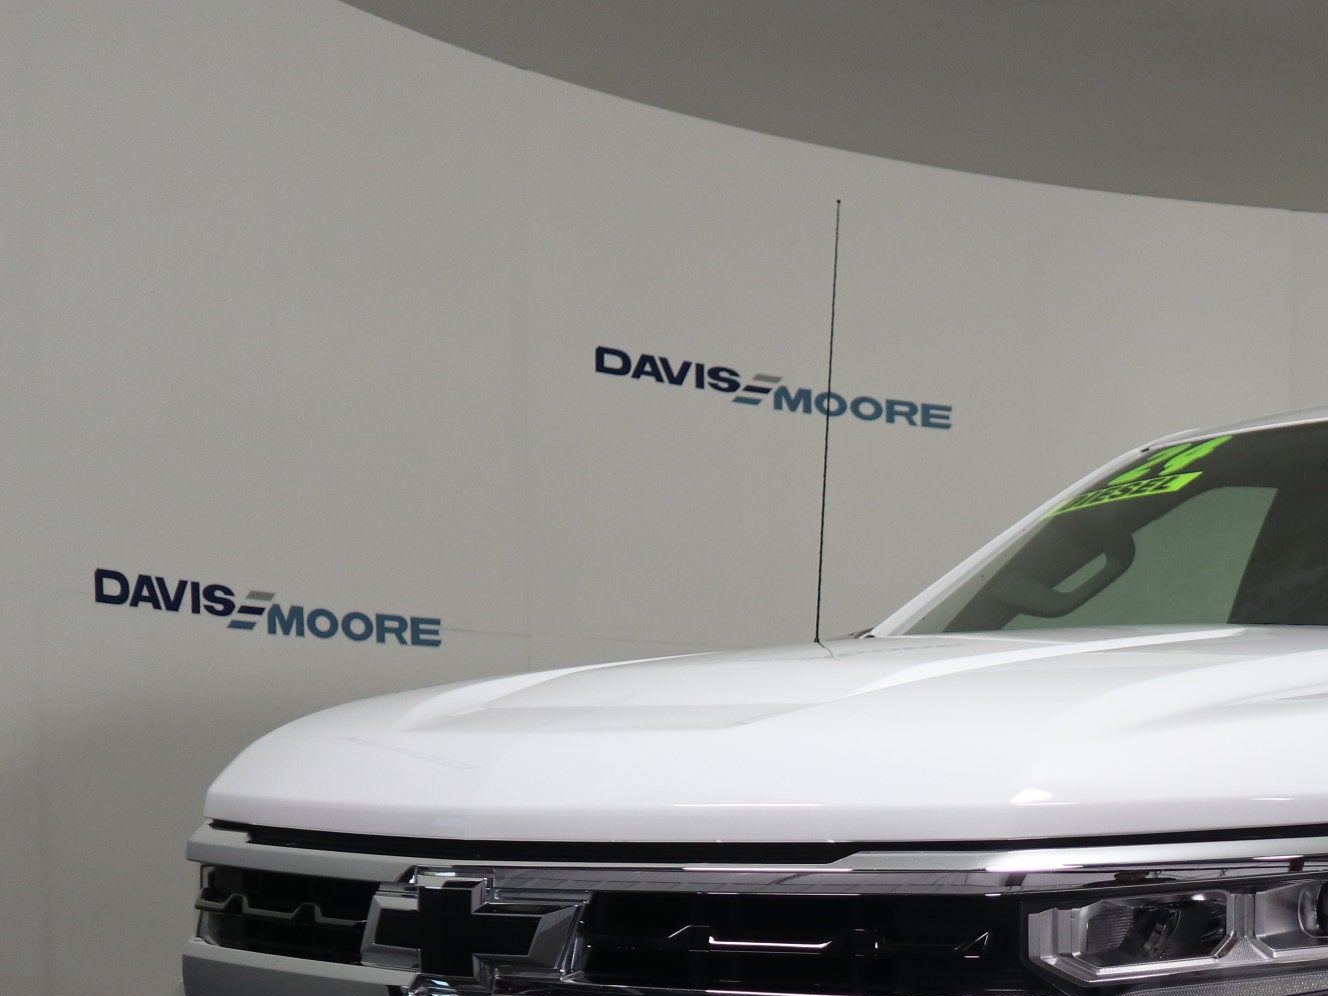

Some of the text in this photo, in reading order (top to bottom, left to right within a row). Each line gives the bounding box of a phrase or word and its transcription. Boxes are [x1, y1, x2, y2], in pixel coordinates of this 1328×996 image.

[595, 346, 952, 429] DAVIS MOORE
[94, 568, 442, 647] DAVIS MOORE
